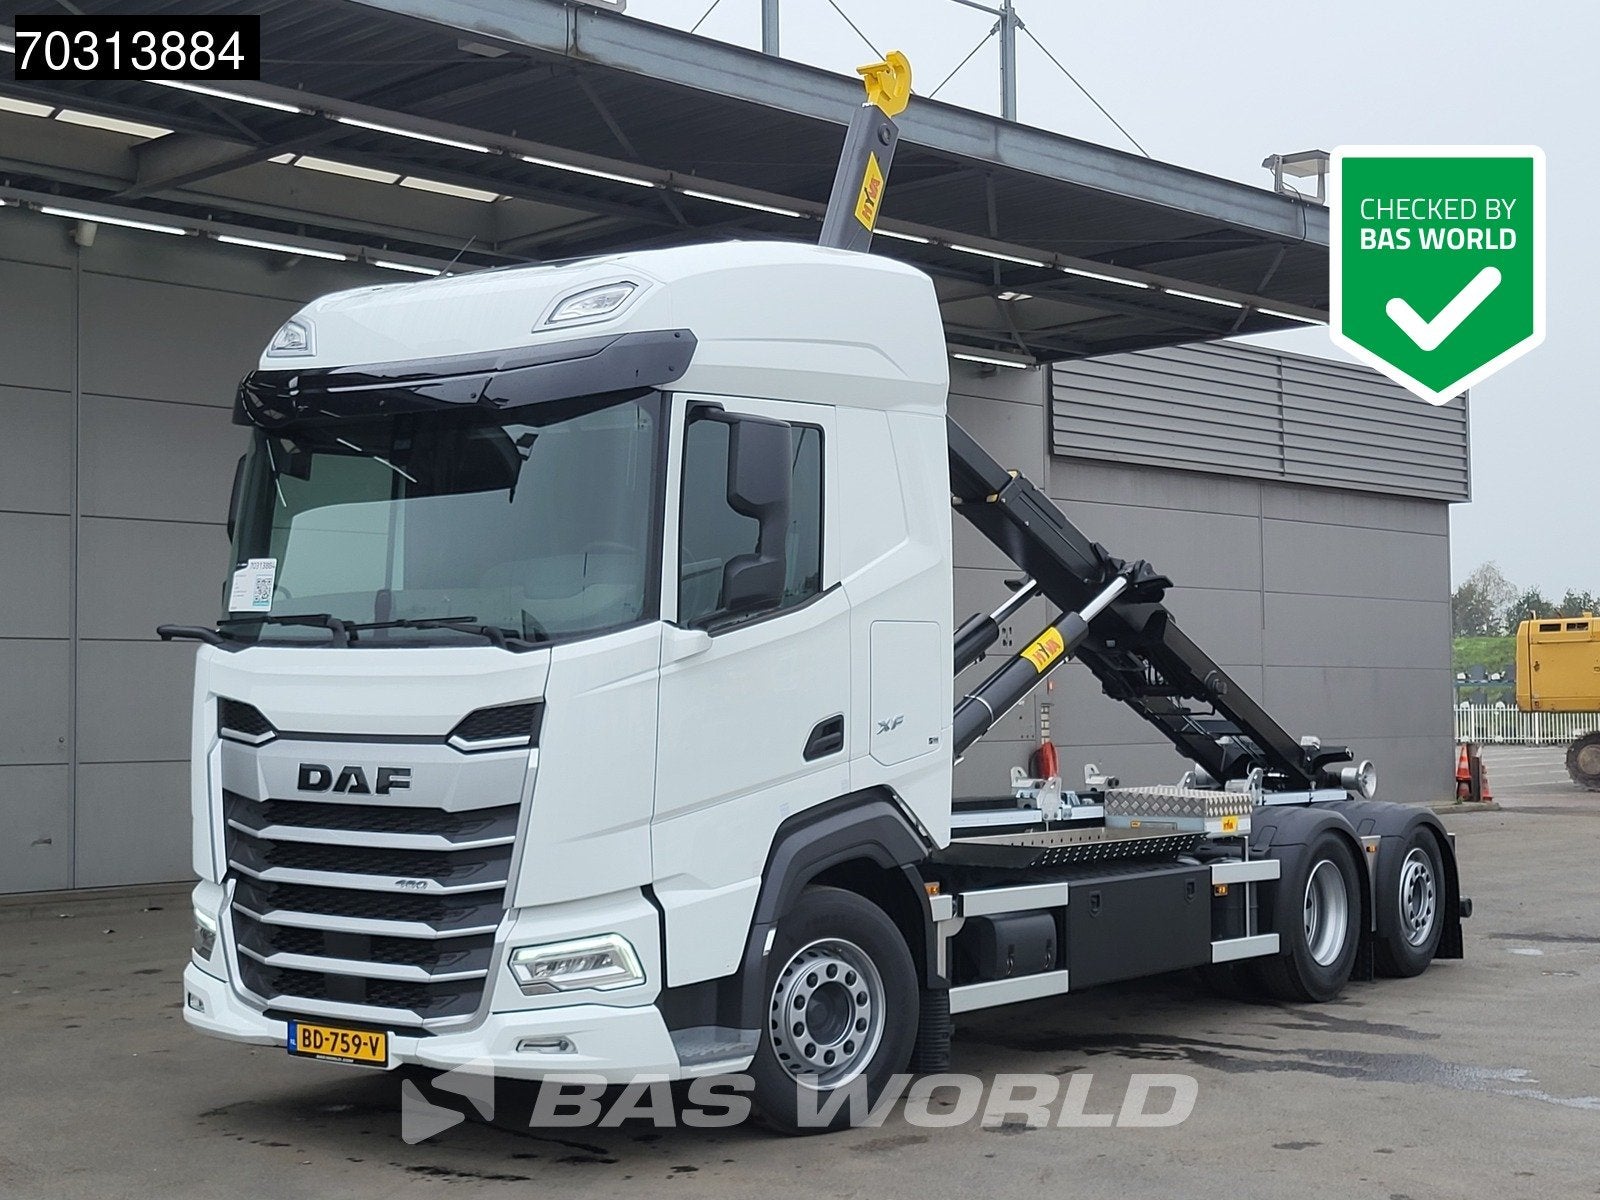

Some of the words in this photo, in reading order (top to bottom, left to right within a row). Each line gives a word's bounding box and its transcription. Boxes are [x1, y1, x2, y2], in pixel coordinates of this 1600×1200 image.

[861, 177, 881, 222] HYVA
[1032, 638, 1061, 666] HYVA
[876, 715, 905, 736] XF
[297, 763, 411, 795] DAF
[302, 1027, 380, 1057] BD-759-V
